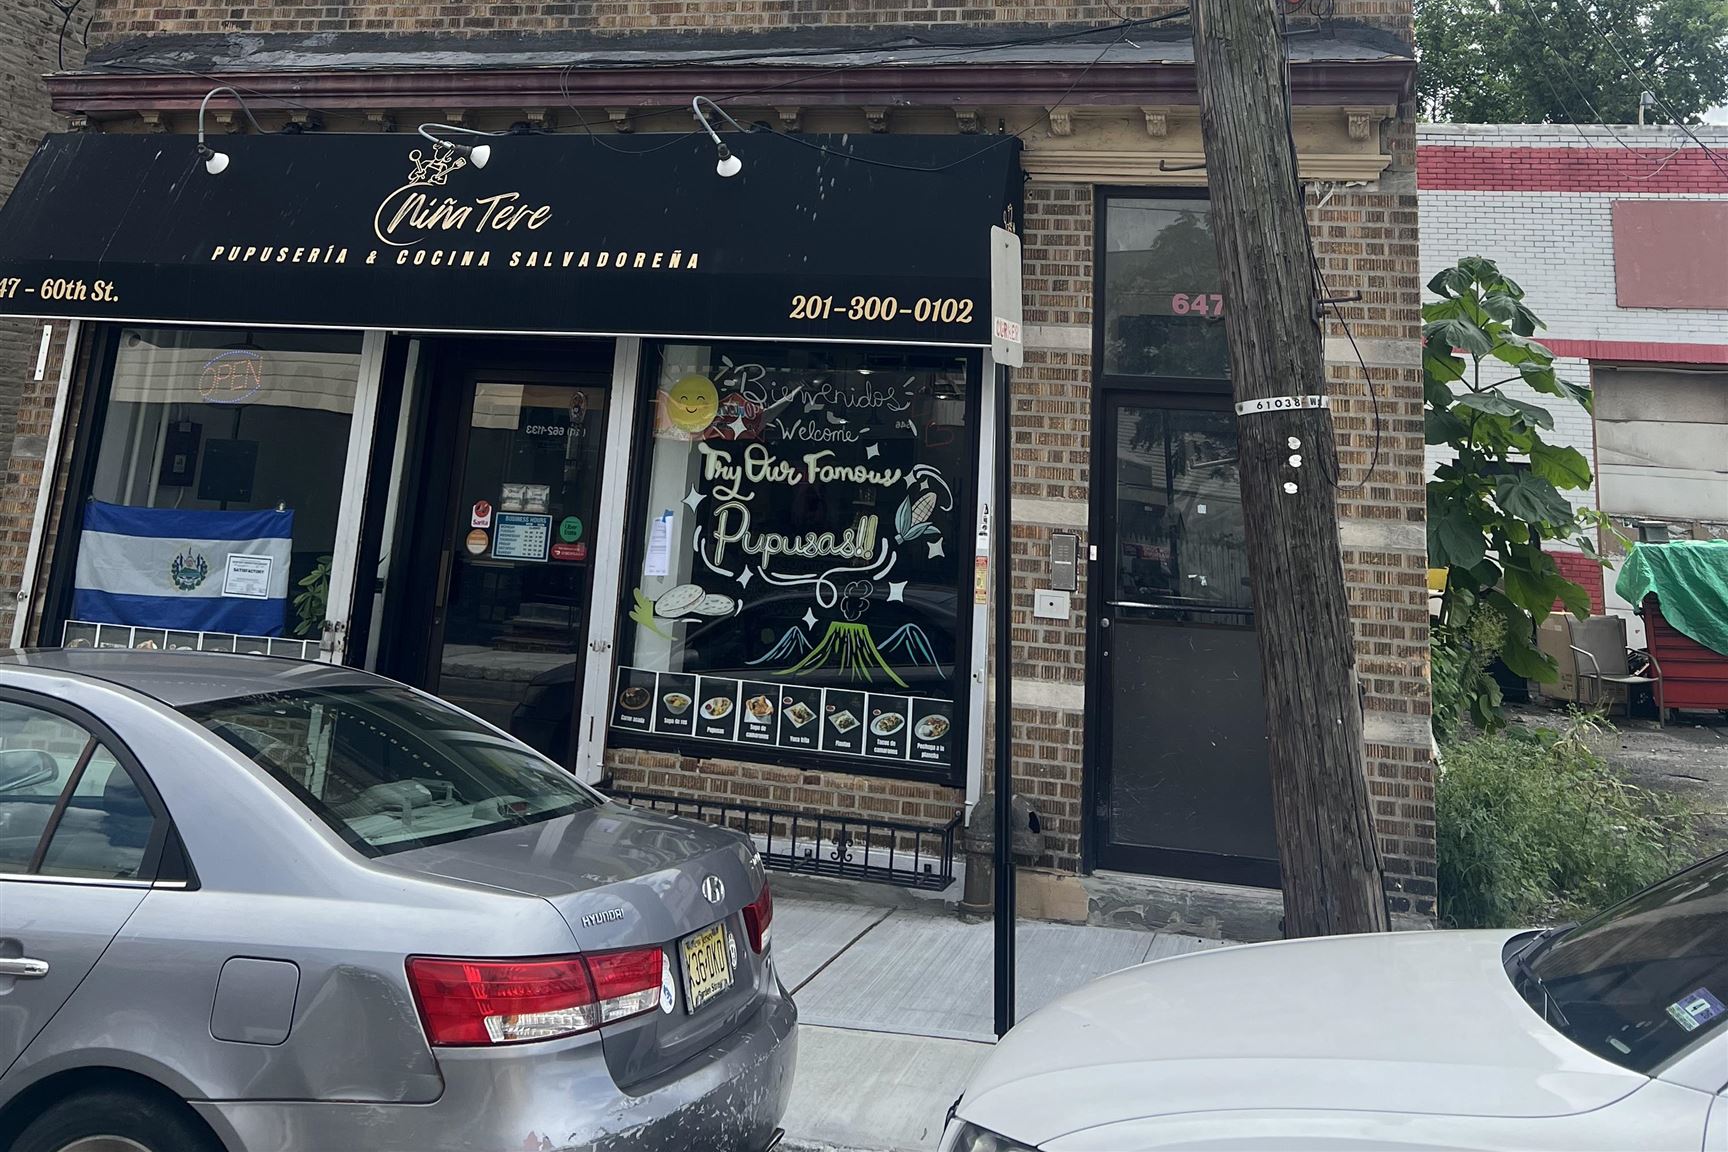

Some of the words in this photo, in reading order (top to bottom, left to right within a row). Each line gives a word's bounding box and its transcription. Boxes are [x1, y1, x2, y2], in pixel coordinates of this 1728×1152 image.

[387, 192, 472, 233] Niña
[476, 192, 552, 232] Tere
[211, 245, 347, 263] PUPUSERÍA
[366, 250, 377, 264] &
[397, 250, 489, 266] COCINA
[508, 249, 698, 268] SALVADOREÑA
[41, 278, 87, 300] 60th
[91, 280, 119, 302] St.
[789, 296, 973, 323] 201-300-0102
[1172, 293, 1223, 316] 647
[199, 356, 263, 396] OPEN
[1256, 398, 1301, 410] 61038
[776, 419, 860, 442] Welcome
[698, 442, 755, 500] Try
[745, 443, 803, 485] Our
[803, 450, 901, 486] Famous
[581, 908, 624, 928] HYUNDAI
